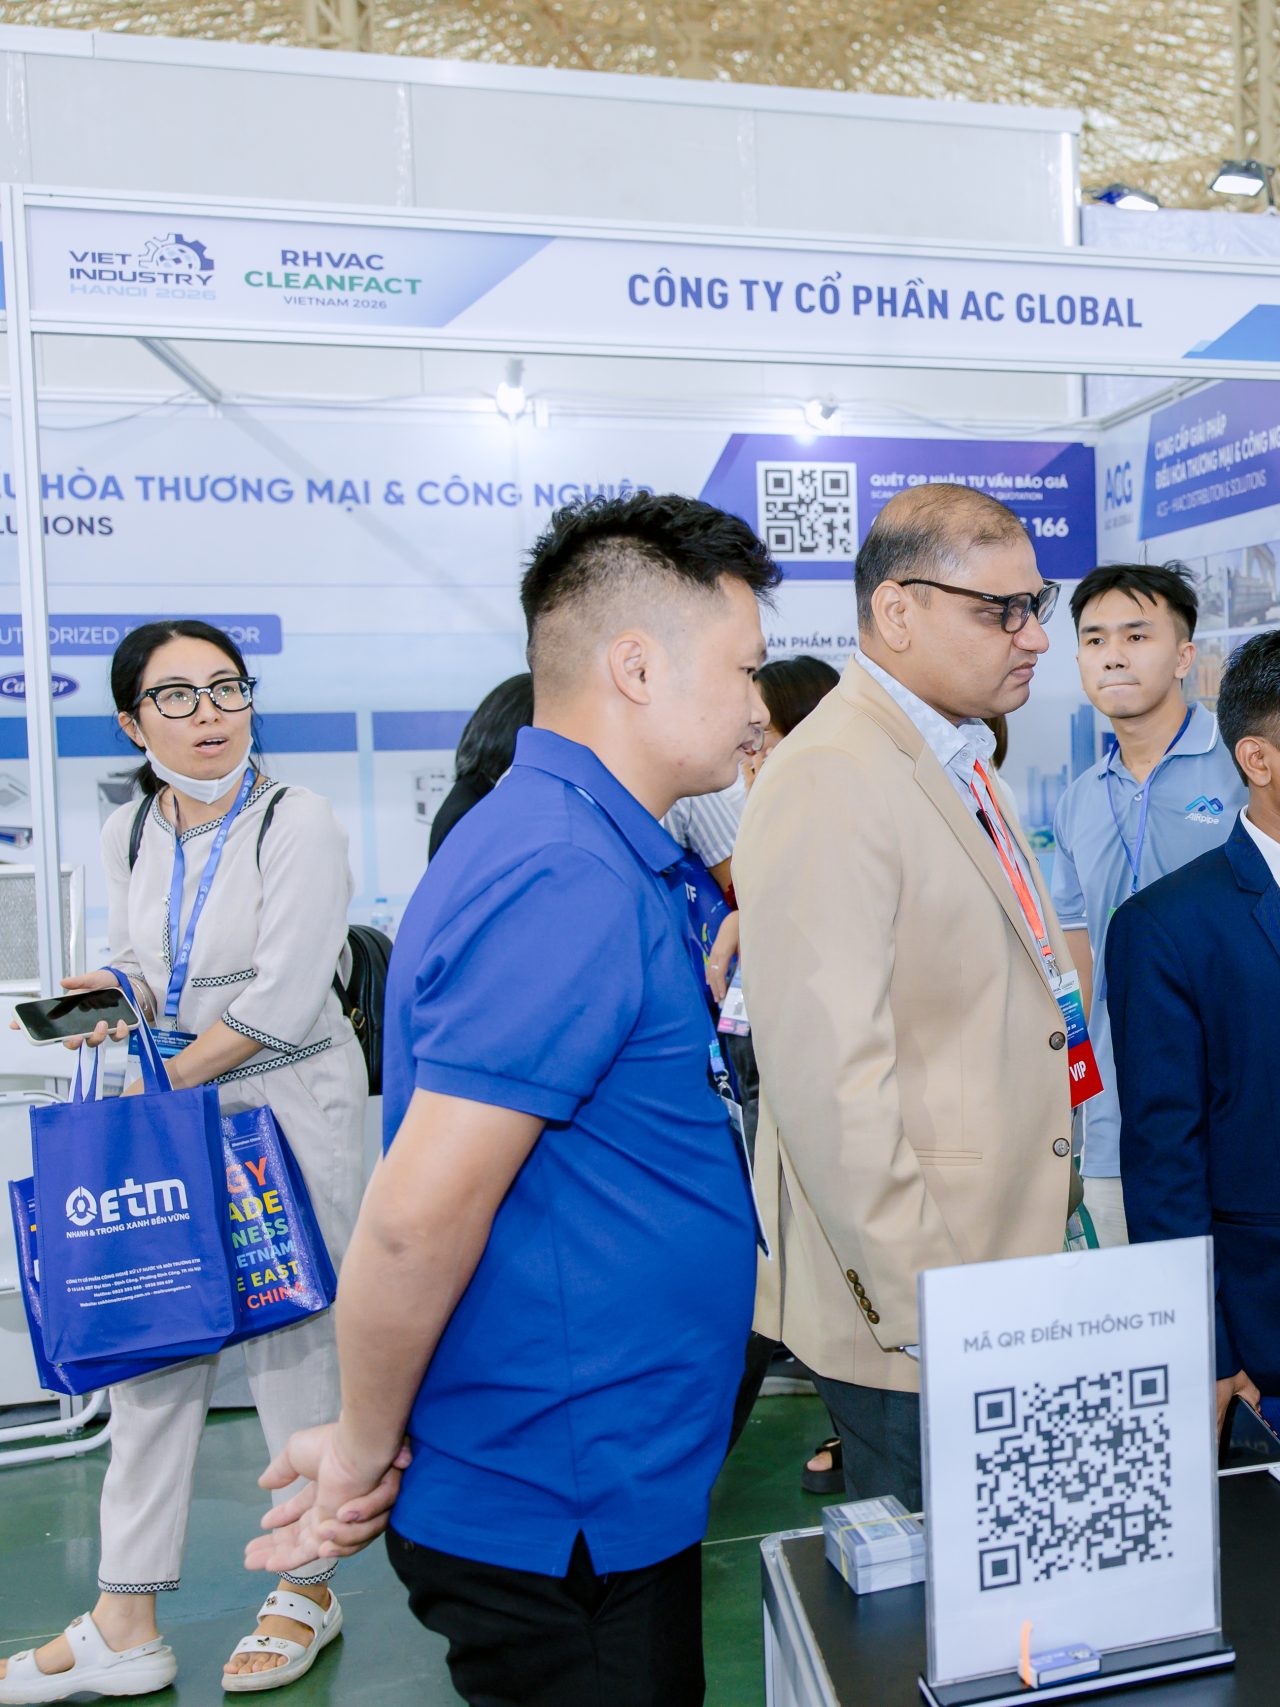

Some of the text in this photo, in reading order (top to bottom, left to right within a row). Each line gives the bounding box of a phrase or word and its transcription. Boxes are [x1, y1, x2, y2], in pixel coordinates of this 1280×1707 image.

[69, 250, 131, 265] VIET
[280, 249, 384, 271] RHVAC
[69, 267, 214, 287] INDUSTRY
[244, 270, 423, 295] CLEANFACT
[69, 283, 217, 301] HANOI 2026
[628, 267, 1143, 328] CÔNG TY CỔ PHẦN AC GLOBAL
[283, 296, 387, 310] VIETNAM 2026
[41, 468, 124, 500] HÒA
[135, 474, 294, 504] THƯƠNG
[307, 478, 369, 512] MẠI
[384, 481, 404, 505] &
[417, 475, 522, 507] CÔNG
[1015, 473, 1043, 489] BÁO
[1044, 473, 1068, 489] GIÁ
[1032, 517, 1069, 538] 166
[0, 626, 119, 645] UTORIZED
[767, 633, 786, 647] ẢN
[1069, 1060, 1087, 1082] VIP
[66, 1230, 89, 1239] NHANH
[90, 1228, 96, 1236] &
[96, 1223, 125, 1236] TRONG
[126, 1219, 150, 1230] XANH
[235, 1240, 294, 1269] ETNAM
[251, 1260, 299, 1287] EAST
[247, 1281, 305, 1309] CHINA
[997, 1330, 1025, 1348] QR
[1077, 1314, 1144, 1336] THÔNG
[1148, 1309, 1176, 1327] TIN
